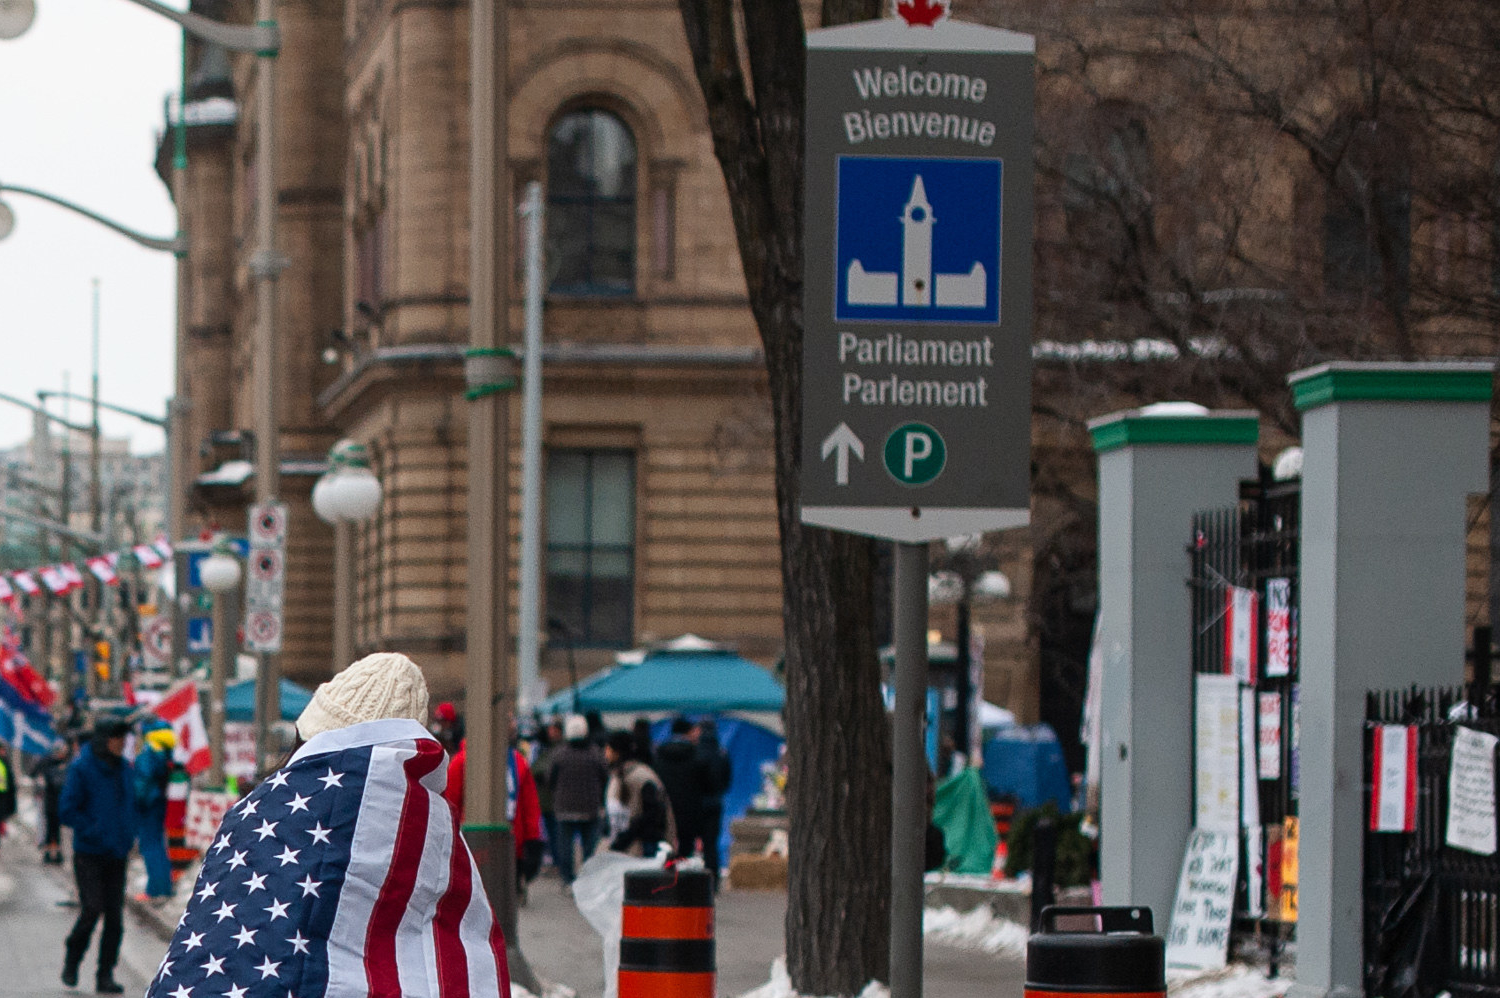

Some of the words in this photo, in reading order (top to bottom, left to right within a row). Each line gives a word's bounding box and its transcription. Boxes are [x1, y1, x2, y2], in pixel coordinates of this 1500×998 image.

[852, 64, 988, 102] Welcome
[843, 108, 997, 147] Bienvenue
[838, 331, 994, 366] Parliament
[843, 372, 989, 406] Parlement
[904, 431, 933, 478] P
